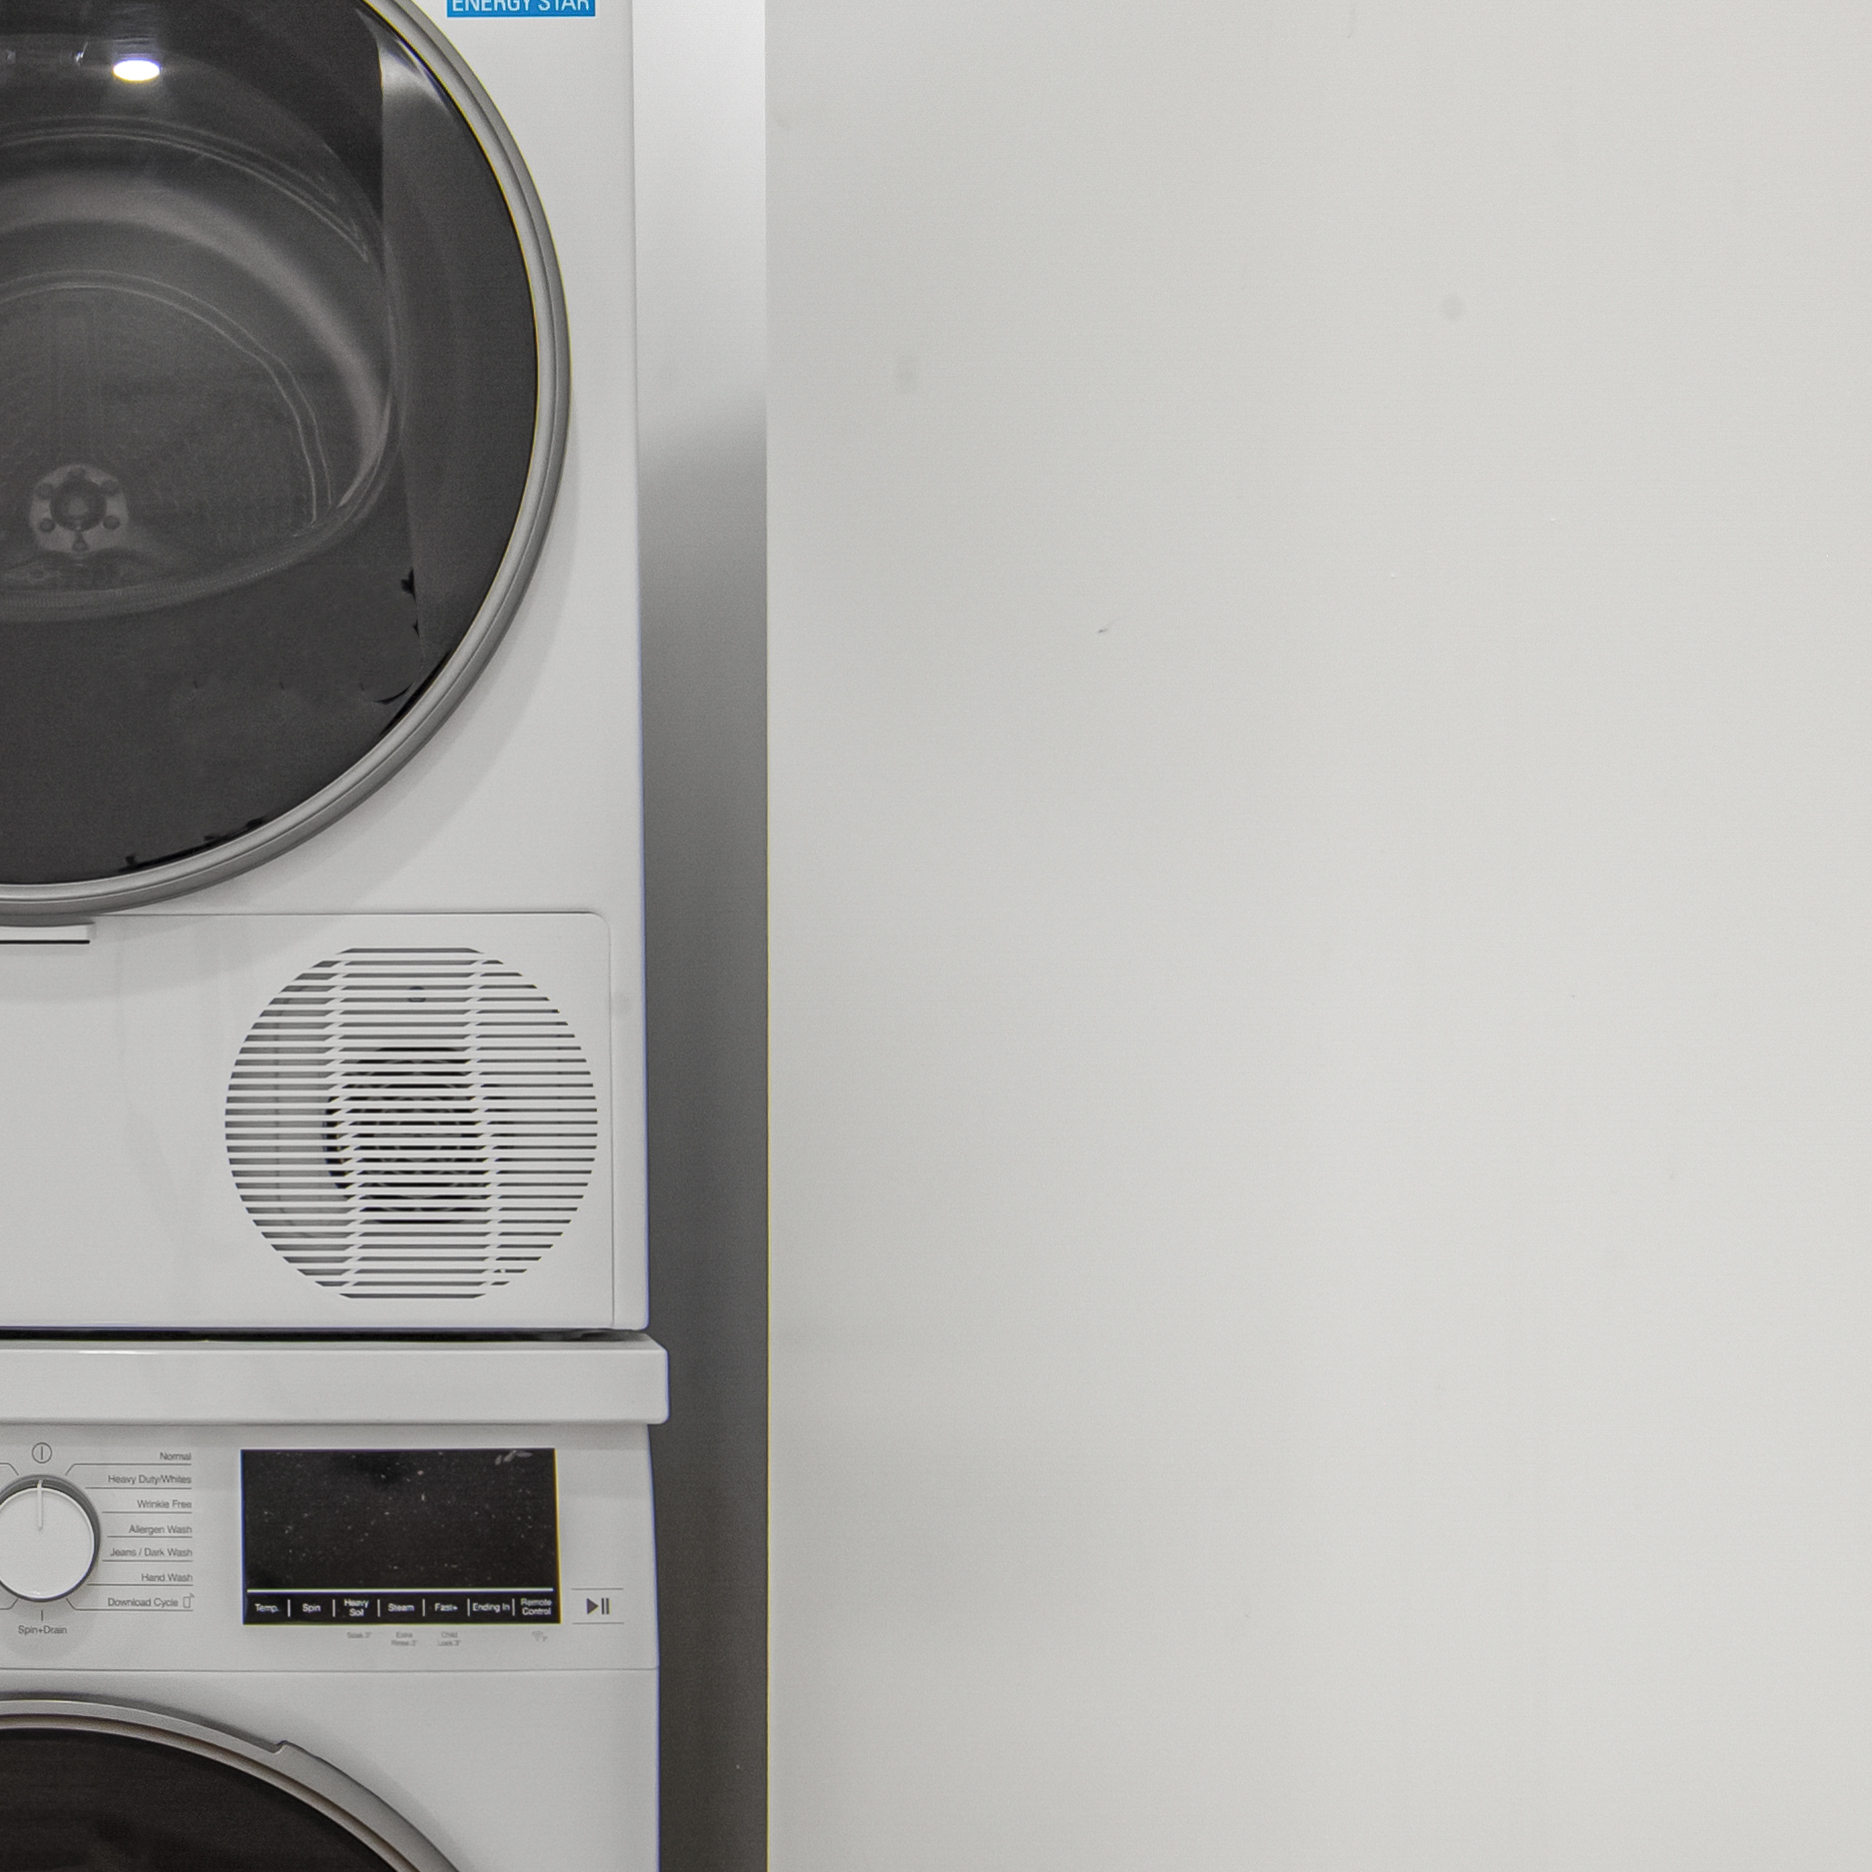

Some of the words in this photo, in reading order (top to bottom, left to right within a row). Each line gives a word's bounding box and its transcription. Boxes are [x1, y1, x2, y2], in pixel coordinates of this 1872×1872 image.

[159, 1452, 192, 1461] Normal
[107, 1474, 136, 1485] Heavy
[136, 1499, 170, 1509] Wrinkle
[172, 1500, 192, 1509] Free
[128, 1524, 165, 1536] Allergen
[167, 1525, 193, 1534] Wash
[109, 1548, 137, 1557] Jeans
[144, 1548, 165, 1557] Dark
[167, 1548, 193, 1557] Wash
[141, 1573, 165, 1582] Hand
[168, 1573, 193, 1582] Wash
[107, 1597, 151, 1607] Download
[153, 1598, 179, 1608] Cycle
[344, 1598, 369, 1608] Heavy
[387, 1603, 415, 1612] Steam
[520, 1598, 552, 1607] Remote
[302, 1603, 321, 1613] Spin
[349, 1608, 364, 1617] Soil
[472, 1603, 501, 1613] Ending
[502, 1603, 511, 1611] In
[521, 1607, 552, 1616] Control
[18, 1625, 67, 1635] Spin+Drain
